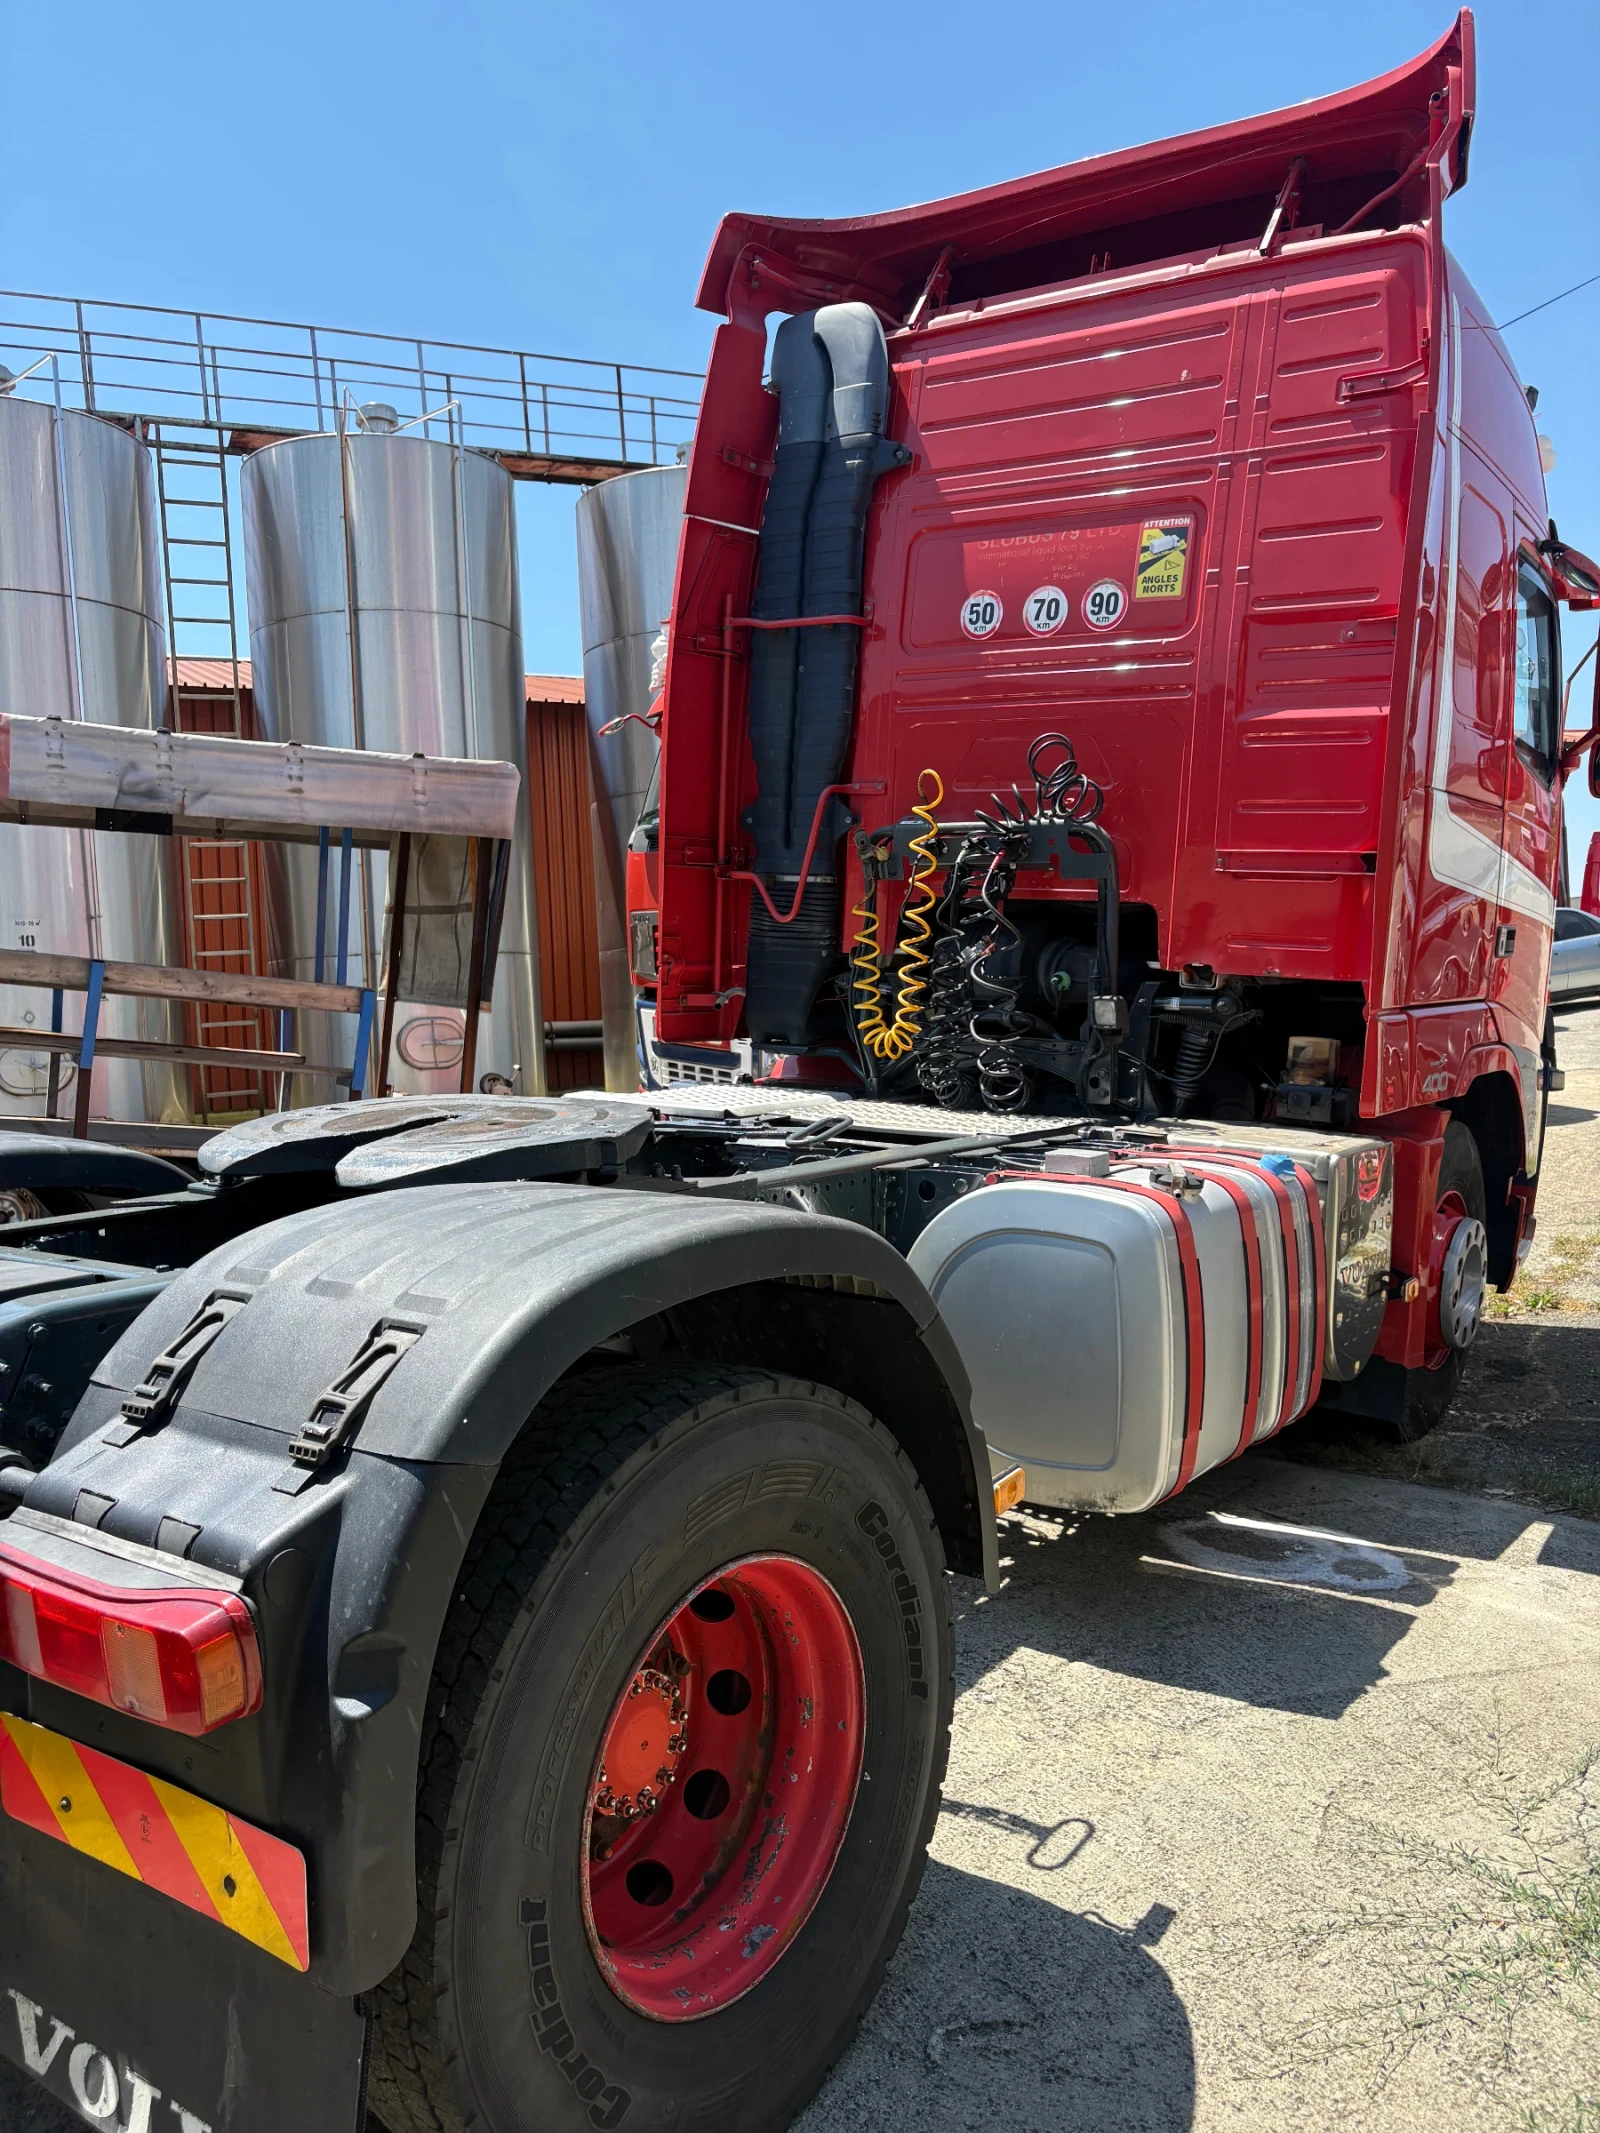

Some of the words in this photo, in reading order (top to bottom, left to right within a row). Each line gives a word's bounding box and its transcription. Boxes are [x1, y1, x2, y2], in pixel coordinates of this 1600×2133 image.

[1144, 517, 1191, 528] ATTENTION
[1141, 574, 1179, 585] ANGLES
[968, 602, 995, 625] 50
[1033, 598, 1060, 621] 70
[1090, 592, 1120, 616] 90
[19, 934, 36, 947] 10
[1421, 1071, 1449, 1094] 400
[855, 1498, 930, 1701] Cordiant
[517, 1896, 633, 2133] Cordiant
